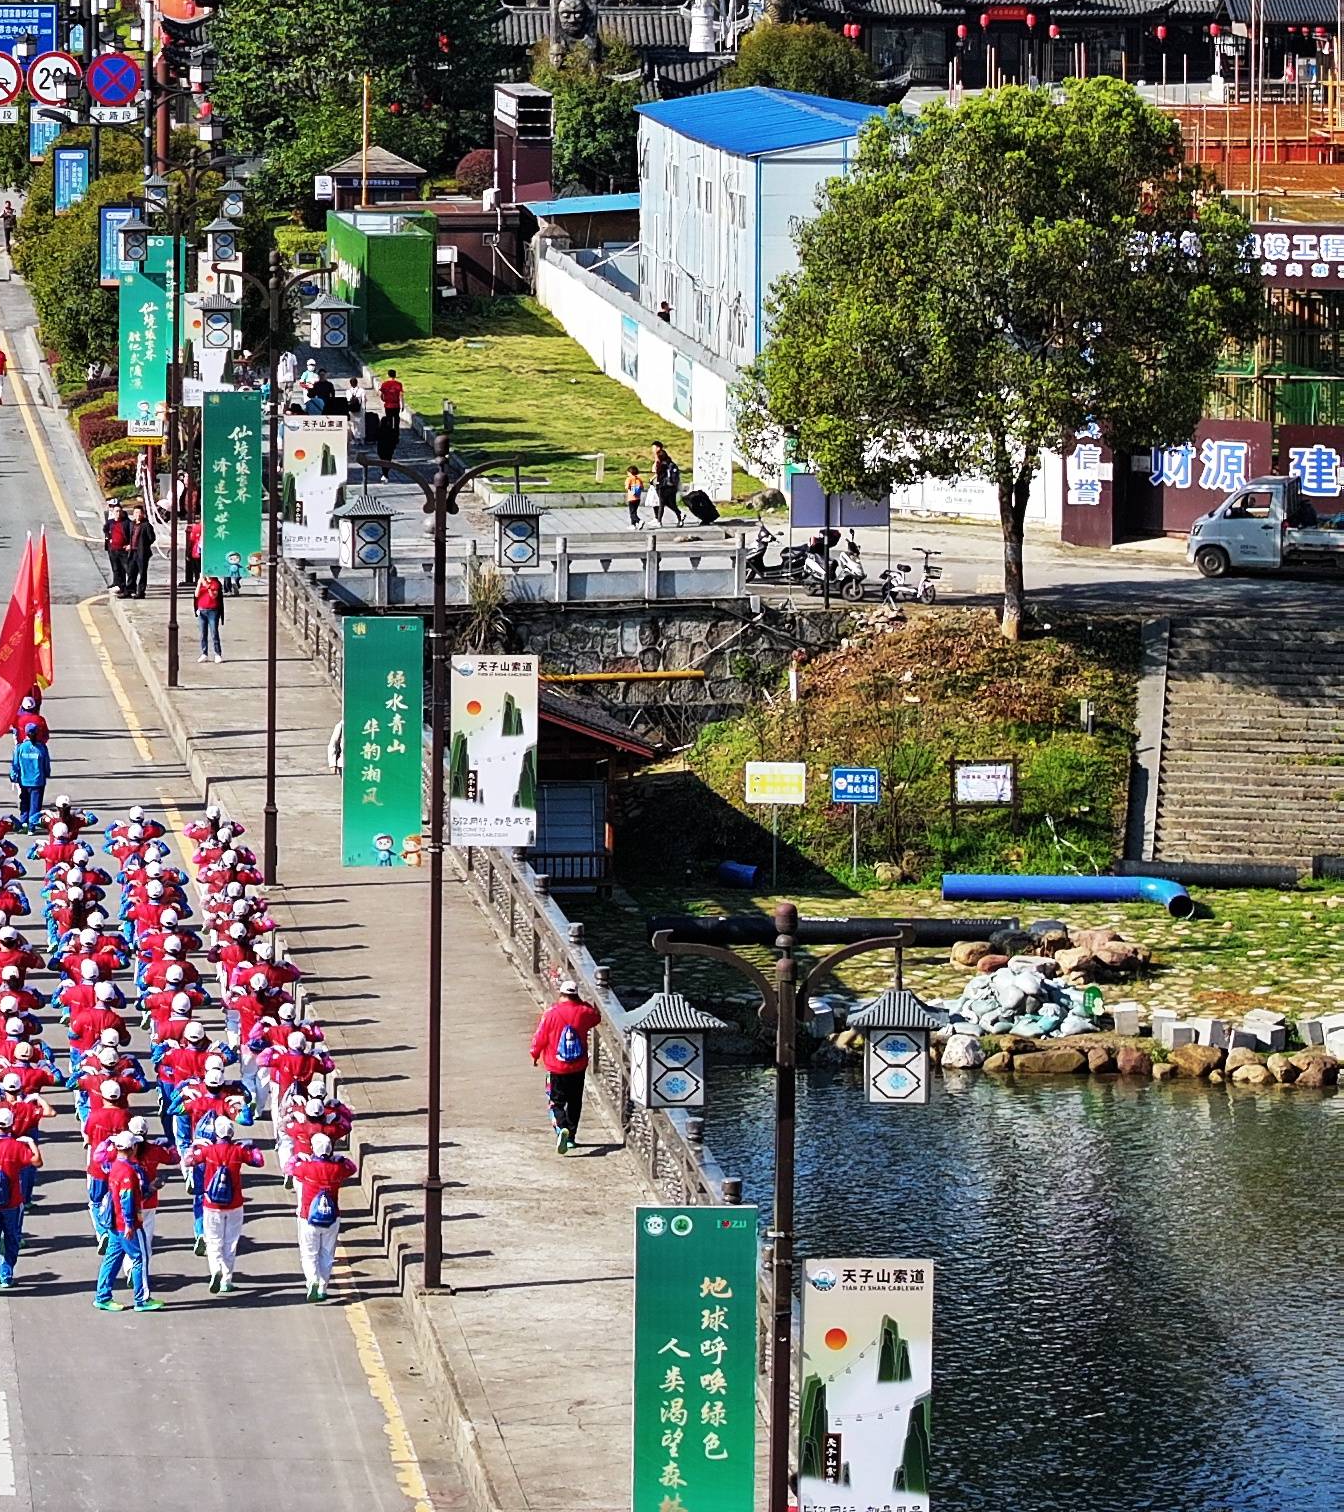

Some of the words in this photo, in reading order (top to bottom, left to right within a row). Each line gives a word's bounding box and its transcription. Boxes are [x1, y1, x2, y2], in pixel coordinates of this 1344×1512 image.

[477, 661, 532, 672] 天子山索道
[384, 670, 409, 755] 绿水青山
[841, 1268, 925, 1284] 天子山索道
[699, 1276, 733, 1462] 地球呼唤绿色
